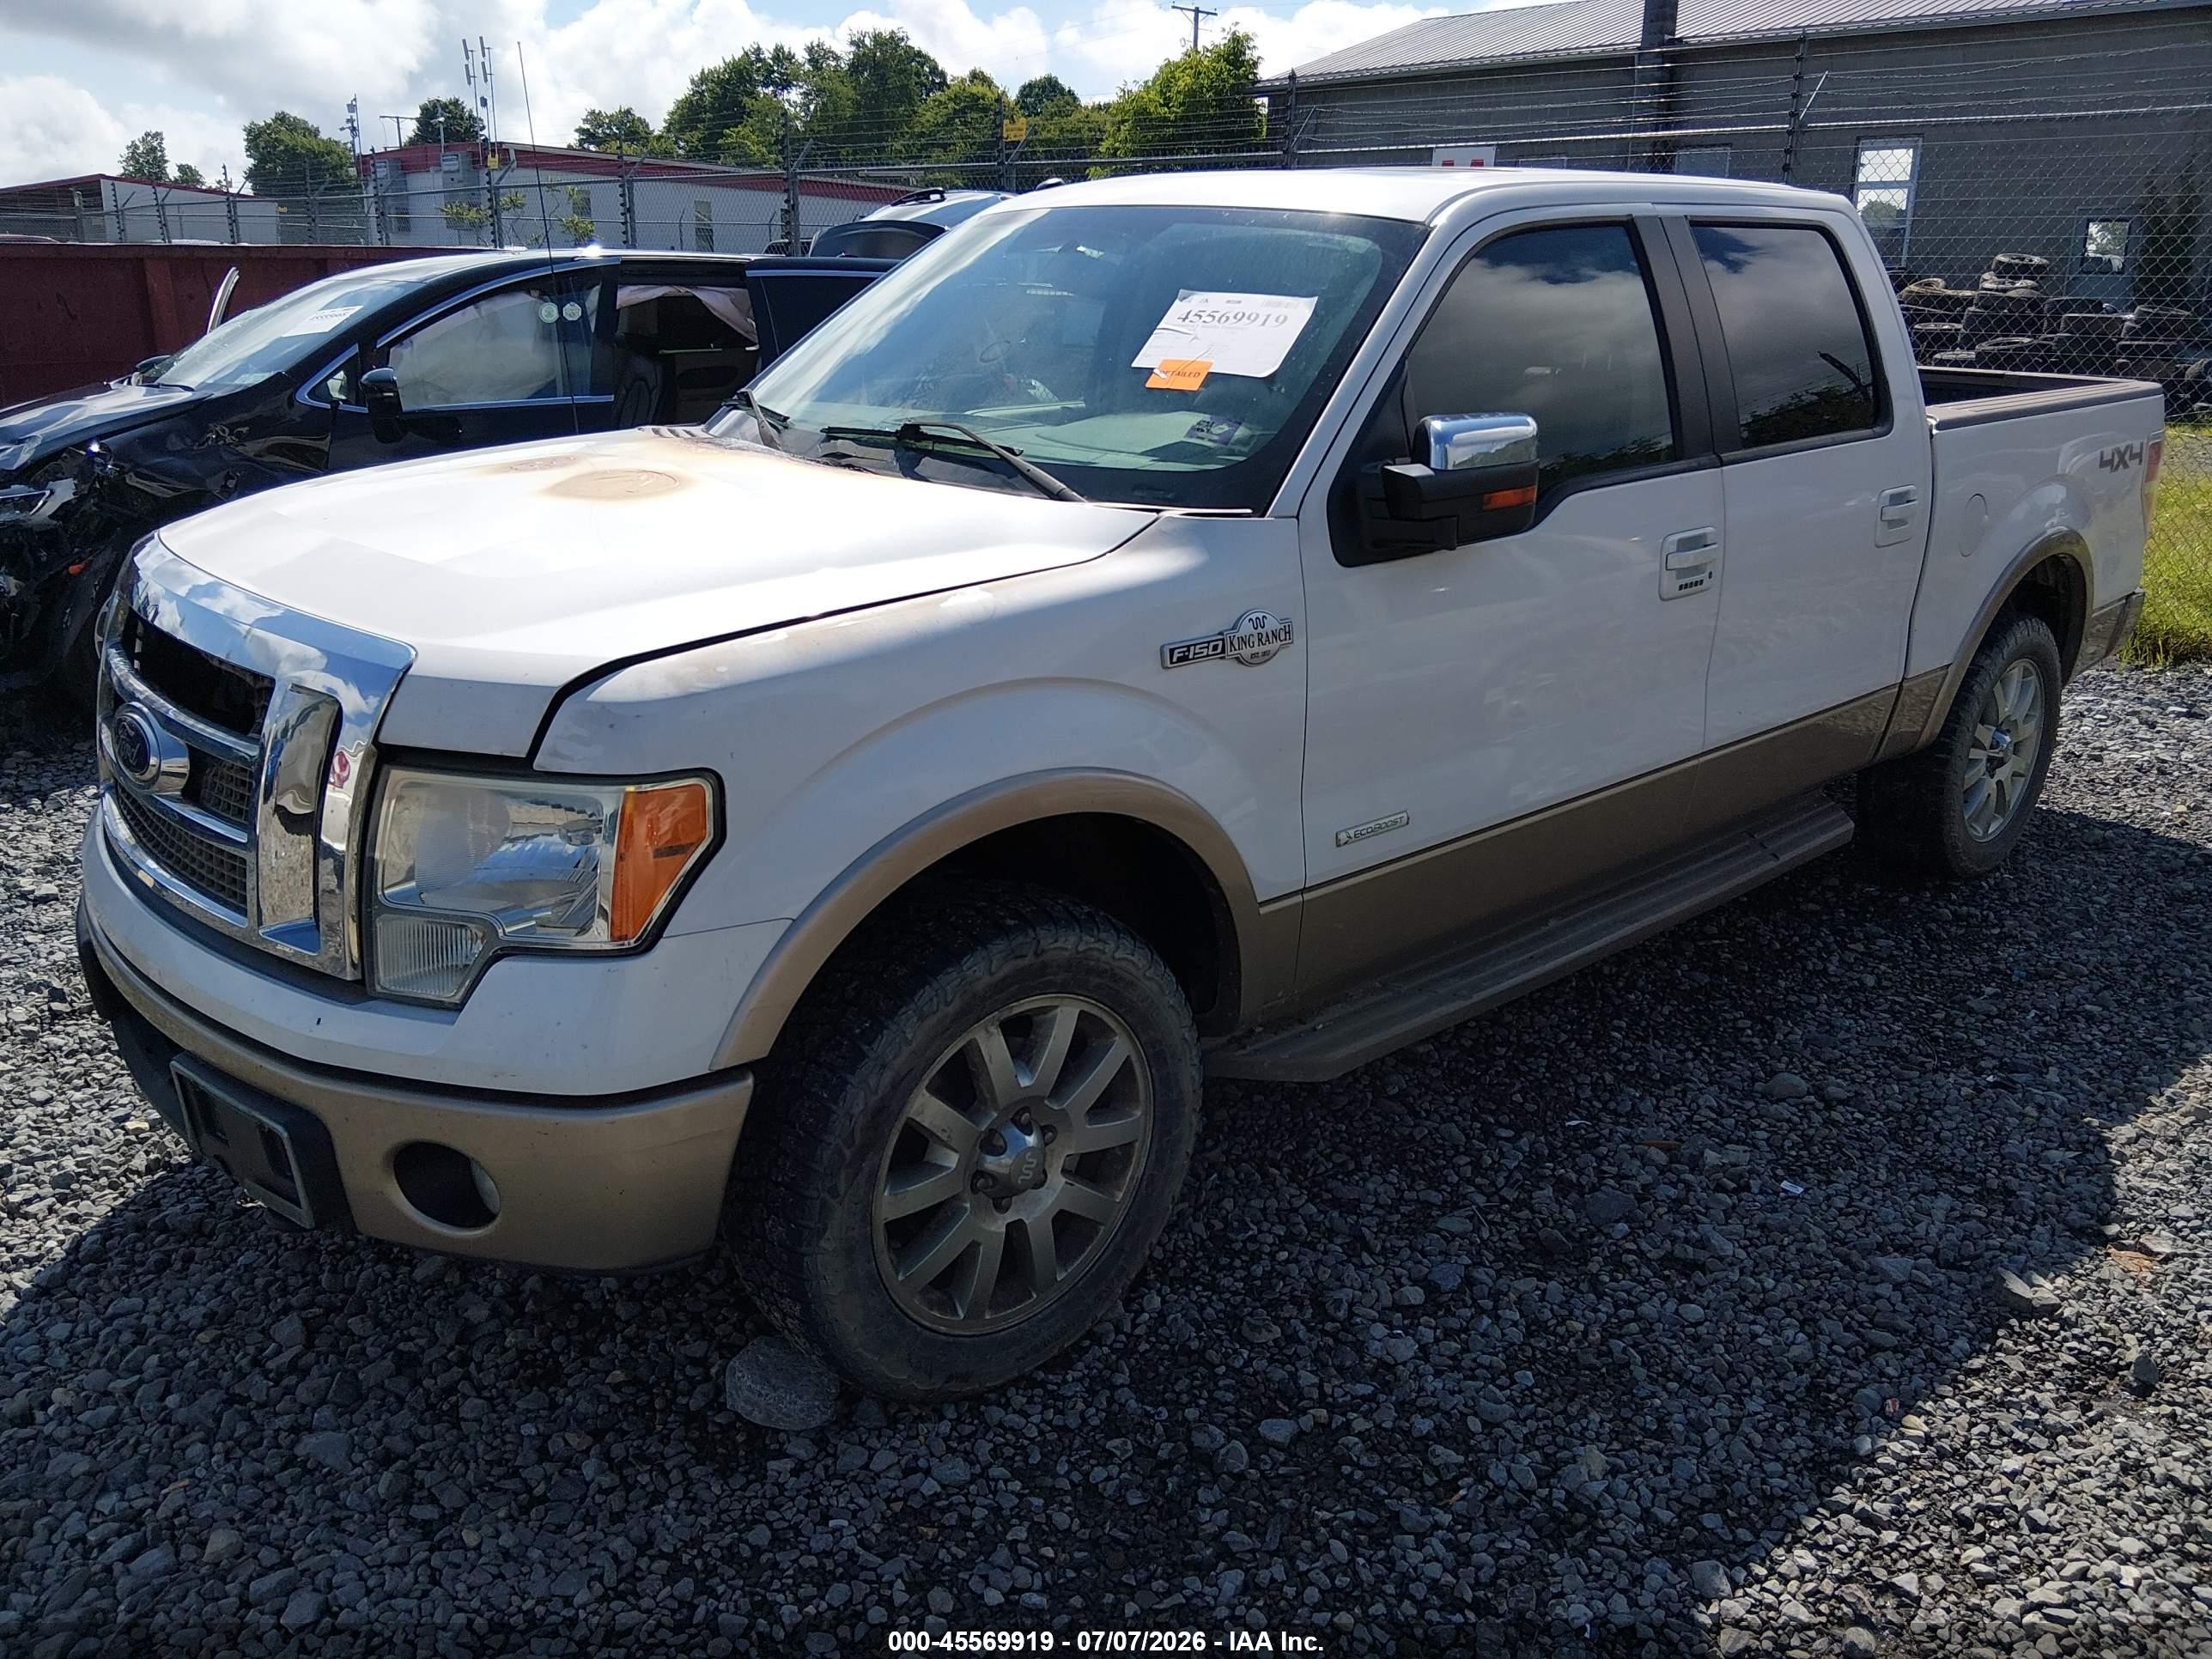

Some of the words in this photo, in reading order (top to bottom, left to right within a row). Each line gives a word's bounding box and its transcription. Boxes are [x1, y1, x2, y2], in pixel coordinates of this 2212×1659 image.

[1177, 309, 1288, 327] 45569919
[1228, 634, 1255, 653] KING
[1257, 624, 1291, 647] RANCH
[1354, 816, 1405, 838] ECOBOOST
